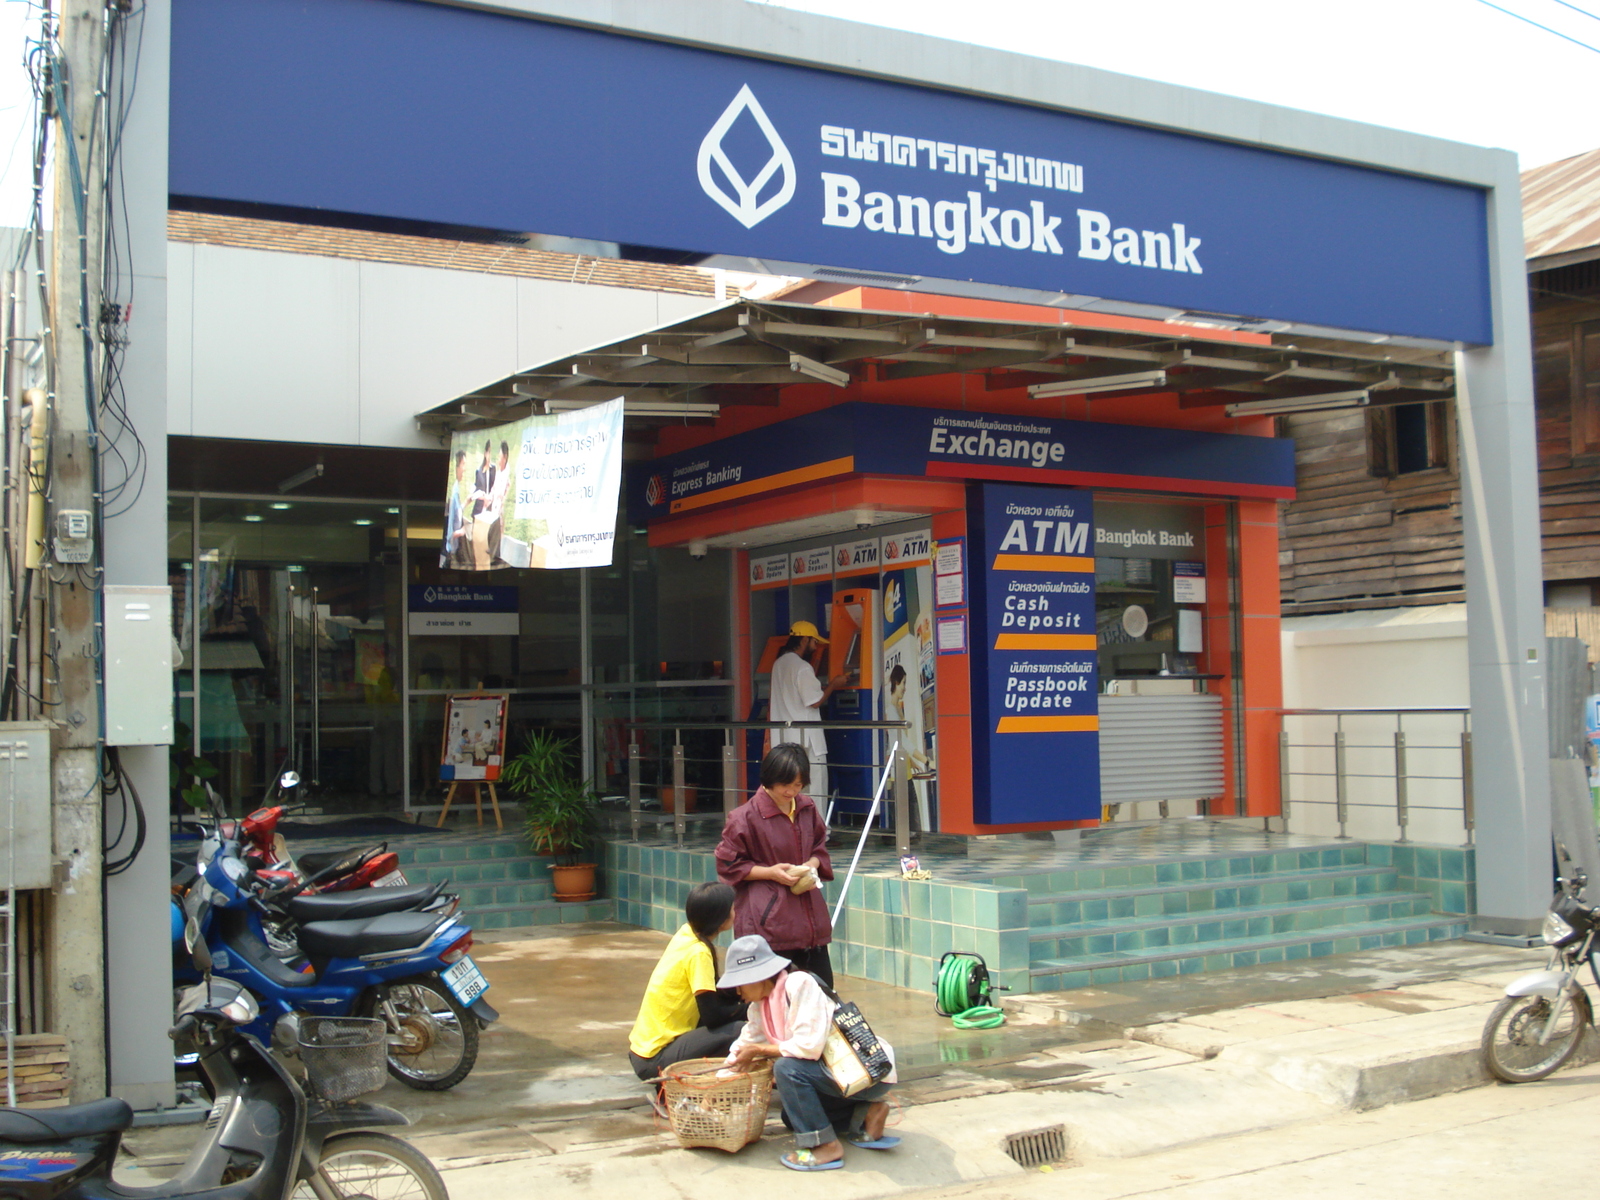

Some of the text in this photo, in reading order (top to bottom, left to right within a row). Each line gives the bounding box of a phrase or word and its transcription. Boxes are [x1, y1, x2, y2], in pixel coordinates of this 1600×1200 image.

[820, 124, 1084, 194] ธนาคารกรุงเทพ
[821, 171, 1203, 275] Bangkok Bank
[929, 427, 1066, 468] Exchange
[671, 465, 742, 496] Express Banking
[1006, 503, 1075, 518] บัวหลวง เอทีเอ็ม
[999, 519, 1090, 554] ATM
[1095, 528, 1195, 548] Bangkok Bank
[853, 548, 877, 564] ATM
[902, 540, 929, 558] ATM
[808, 558, 820, 566] Cash
[808, 563, 828, 573] Deposit
[1008, 581, 1090, 594] บัวหลวงเงินฝากฉับไว
[437, 592, 472, 602] Bangkok
[1005, 595, 1049, 611] Cash
[1002, 612, 1081, 631] Deposit
[885, 652, 902, 673] ATM
[1010, 661, 1093, 674] บันทึกรายการอัตโนมัติ
[1006, 676, 1088, 692] Passbook
[1004, 692, 1072, 712] Update
[464, 981, 482, 999] 998
[835, 1011, 855, 1025] MILK
